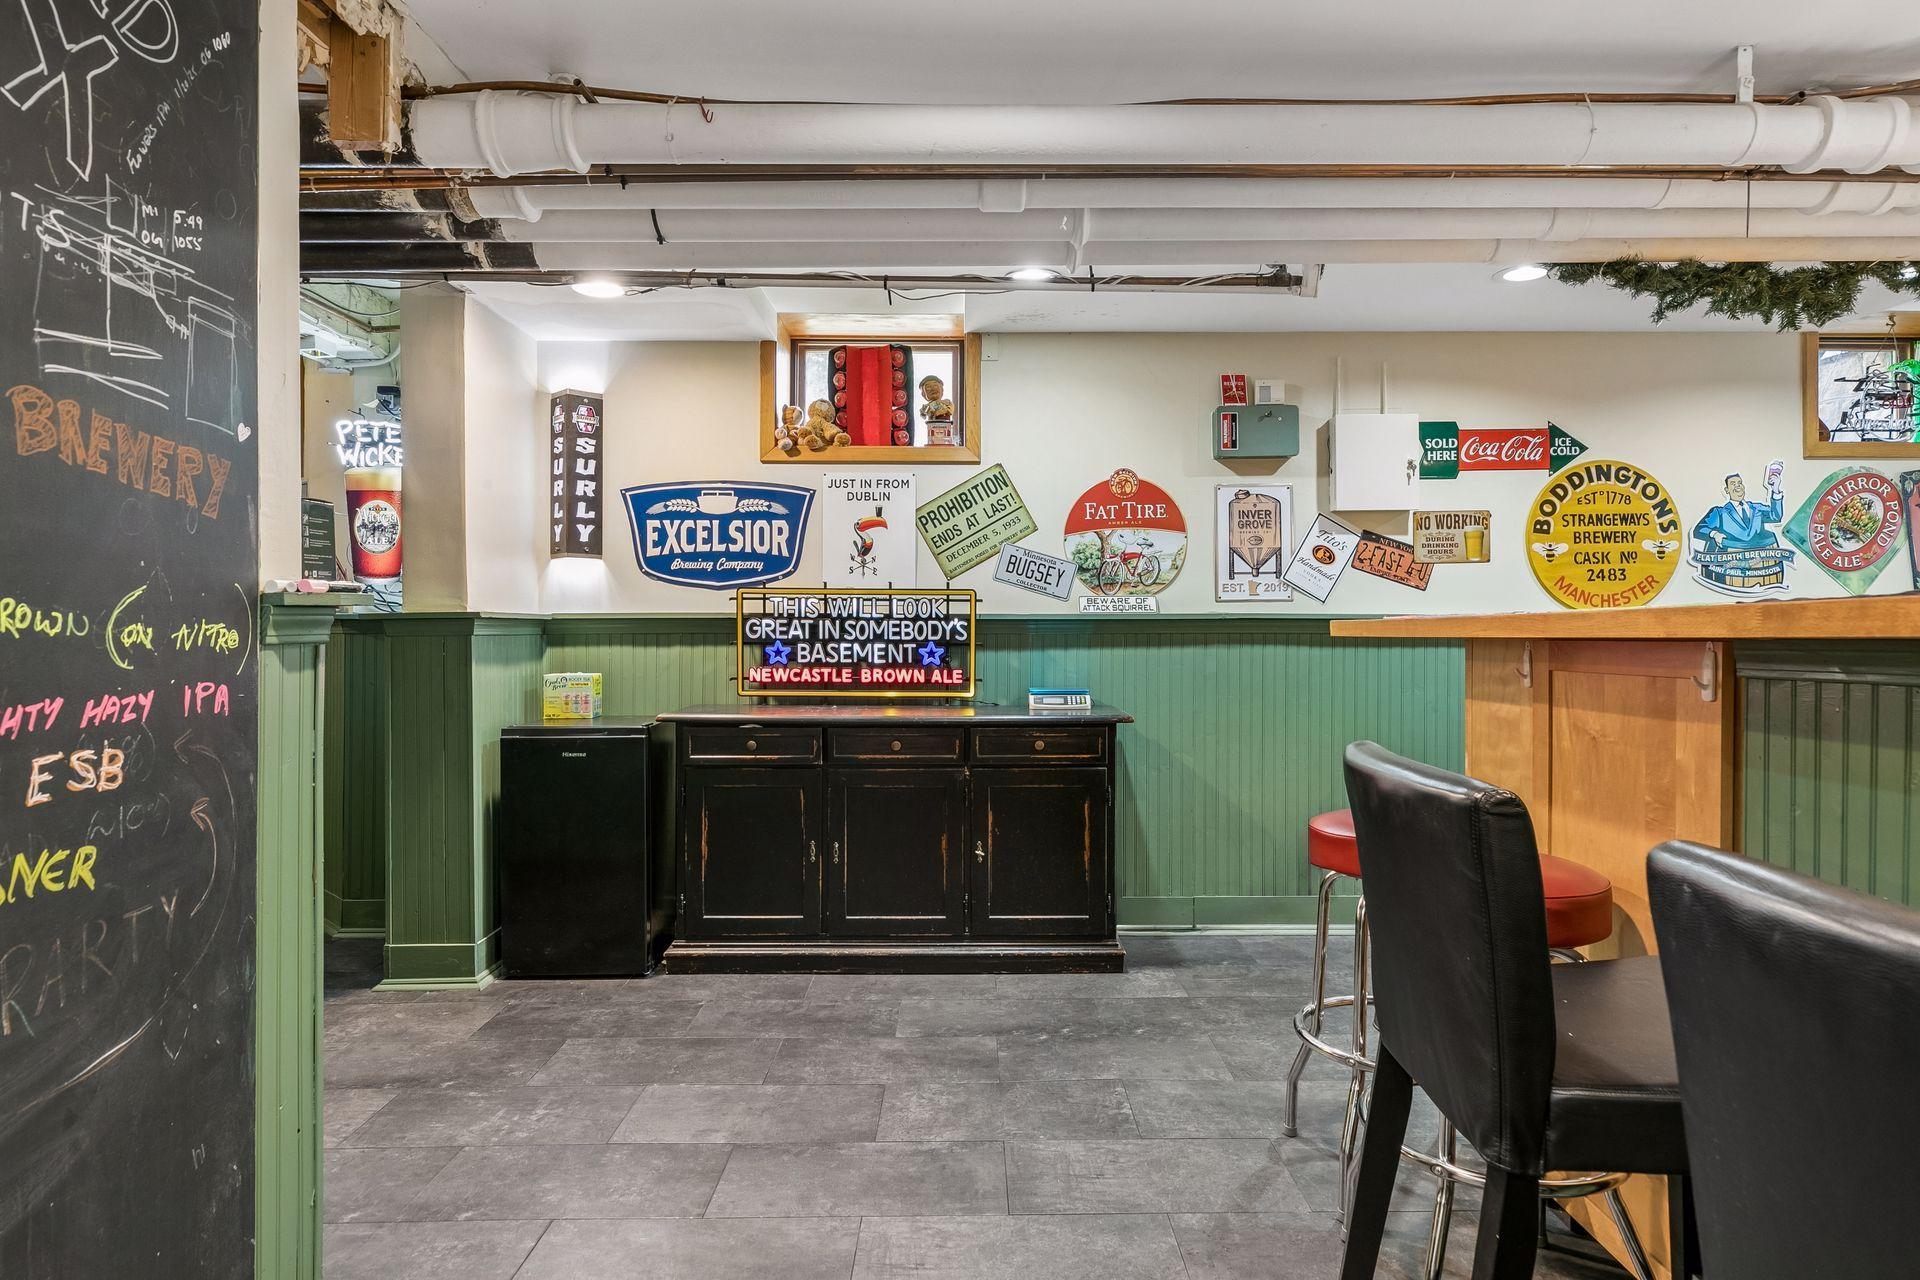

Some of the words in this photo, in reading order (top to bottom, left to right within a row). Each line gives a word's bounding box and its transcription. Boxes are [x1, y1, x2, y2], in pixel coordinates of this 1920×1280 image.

[1425, 438, 1458, 450] SOLD
[1460, 435, 1546, 463] Coca-Cola
[1554, 437, 1572, 447] ICE
[5, 384, 232, 519] BREWERY
[1427, 450, 1458, 461] HERE
[1550, 446, 1580, 456] COLD
[553, 437, 564, 543] SURLY
[575, 437, 597, 543] SURLY
[828, 479, 856, 489] JUST
[860, 479, 872, 489] IN
[876, 479, 910, 489] FROM
[1827, 477, 1891, 507] MIRROR
[847, 491, 891, 502] DUBLIN
[917, 470, 1010, 533] PROHIBITION
[1533, 463, 1678, 536] BODDINGTONS
[1606, 490, 1632, 505] 1778
[930, 524, 963, 550] ENDS
[965, 513, 980, 531] AT
[983, 492, 1018, 520] LAST!
[1238, 509, 1273, 520] INVER
[1416, 515, 1431, 531] NO
[1435, 513, 1489, 531] WORKING
[1561, 512, 1650, 528] STRANGEWAYS
[1237, 519, 1273, 530] GROVE
[1876, 500, 1900, 548] POND
[645, 519, 790, 557] EXCELSIOR
[945, 534, 991, 563] DECEMBER
[992, 528, 1002, 538] 5,
[1002, 515, 1022, 531] 1933
[1315, 529, 1349, 553] Tito's
[1379, 538, 1398, 549] NEW
[1573, 531, 1637, 545] BREWERY
[1813, 523, 1833, 560] PALE
[1832, 554, 1862, 569] ALE
[670, 558, 714, 572] Brewing
[716, 557, 764, 572] Company
[1022, 550, 1057, 566] Minnesota
[1573, 551, 1612, 565] CASK
[1696, 554, 1715, 562] FLAT
[1717, 553, 1743, 562] EARTH
[1744, 550, 1781, 559] BREWING
[1005, 554, 1066, 588] BUGSEY
[1298, 556, 1338, 581] Handmade
[1586, 568, 1627, 582] 2483
[1708, 564, 1725, 574] SAINT
[1745, 566, 1781, 576] MINNESOTA
[1016, 578, 1048, 591] COLLECTOR
[1222, 583, 1246, 593] EST.
[1554, 574, 1660, 608] MANCHESTER
[769, 596, 820, 618] THIS
[827, 596, 884, 618] WILL
[892, 596, 945, 618] LOOK
[1082, 604, 1112, 612] ATTACK
[1112, 604, 1154, 612] SQUIRREL
[1086, 597, 1131, 605] BEWARE
[1135, 597, 1149, 605] OF
[745, 618, 814, 640] GREAT
[818, 619, 840, 640] IN
[843, 617, 968, 641] SOMEBODY'S
[796, 642, 917, 664] BASEMENT
[749, 667, 853, 684] NEWCASTLE
[860, 667, 926, 684] BROWN
[931, 668, 963, 684] ALE
[80, 689, 155, 729] HAZY
[183, 680, 230, 718] IPA
[26, 747, 126, 808] ESB
[0, 845, 98, 906] NER
